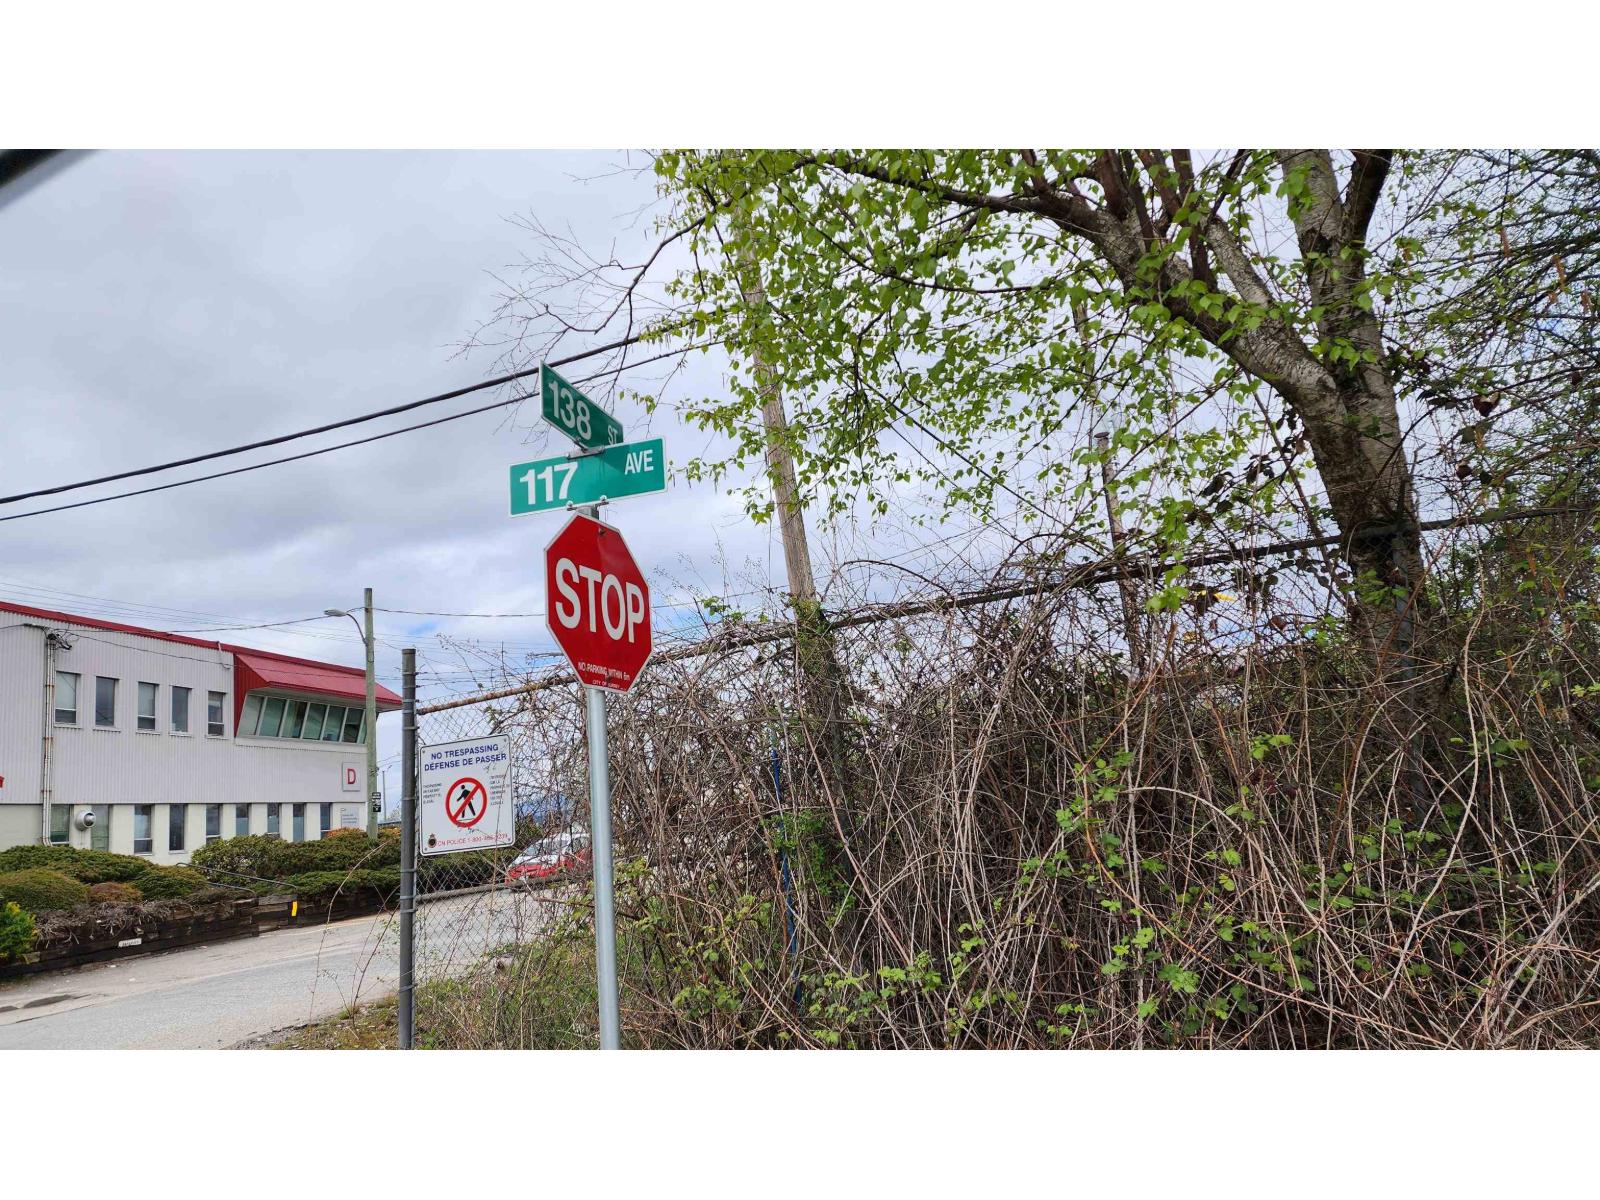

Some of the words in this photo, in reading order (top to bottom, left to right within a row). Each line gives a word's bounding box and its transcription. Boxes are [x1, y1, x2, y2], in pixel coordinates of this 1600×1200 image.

[548, 381, 592, 440] 138
[607, 425, 618, 445] ST
[519, 461, 578, 505] 117
[624, 449, 654, 475] AVE
[555, 557, 645, 644] STOP
[577, 661, 586, 671] NO
[587, 663, 607, 676] PARKING
[431, 752, 443, 760] NO
[444, 743, 499, 758] TRESPASSING
[462, 757, 473, 766] DE
[475, 753, 507, 764] PASSER
[347, 768, 357, 785] D
[446, 838, 466, 846] POLICE
